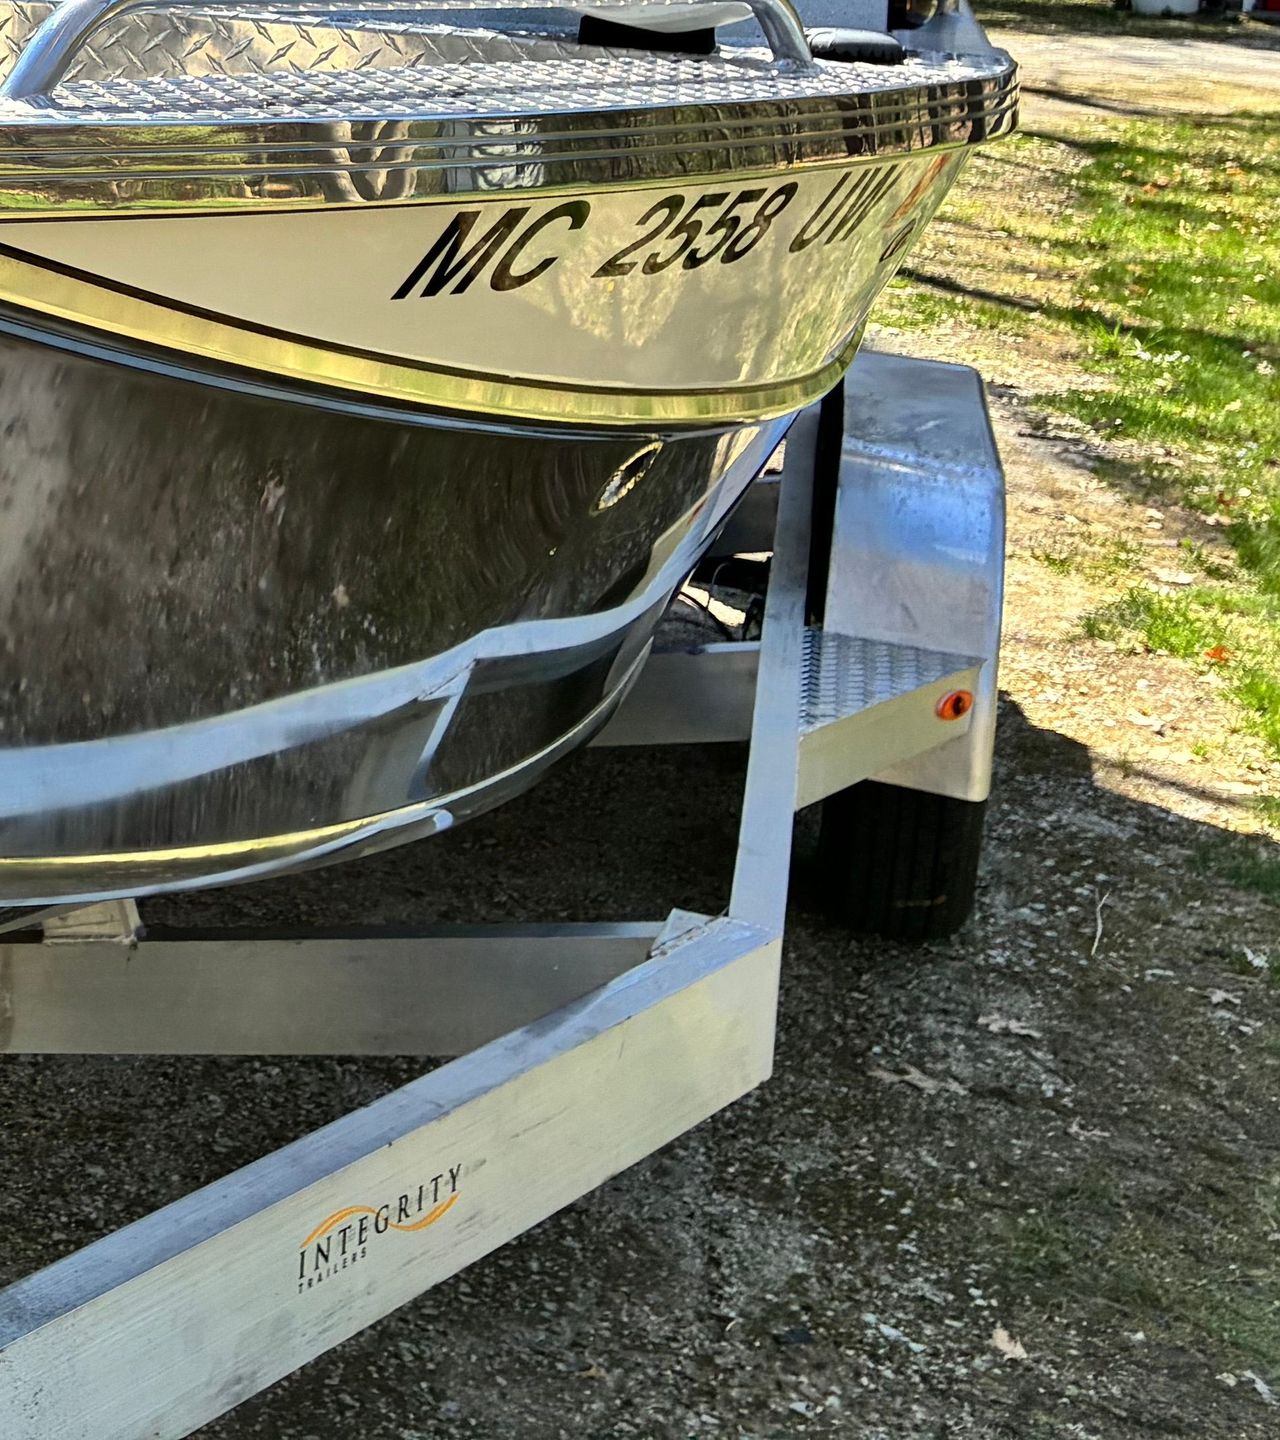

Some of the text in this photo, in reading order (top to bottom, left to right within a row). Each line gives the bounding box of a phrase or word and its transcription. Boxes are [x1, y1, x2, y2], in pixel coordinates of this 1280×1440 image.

[390, 163, 908, 300] MC 2558 UW
[298, 1163, 462, 1280] INTEGRITY
[298, 1246, 367, 1294] TRAILERS
